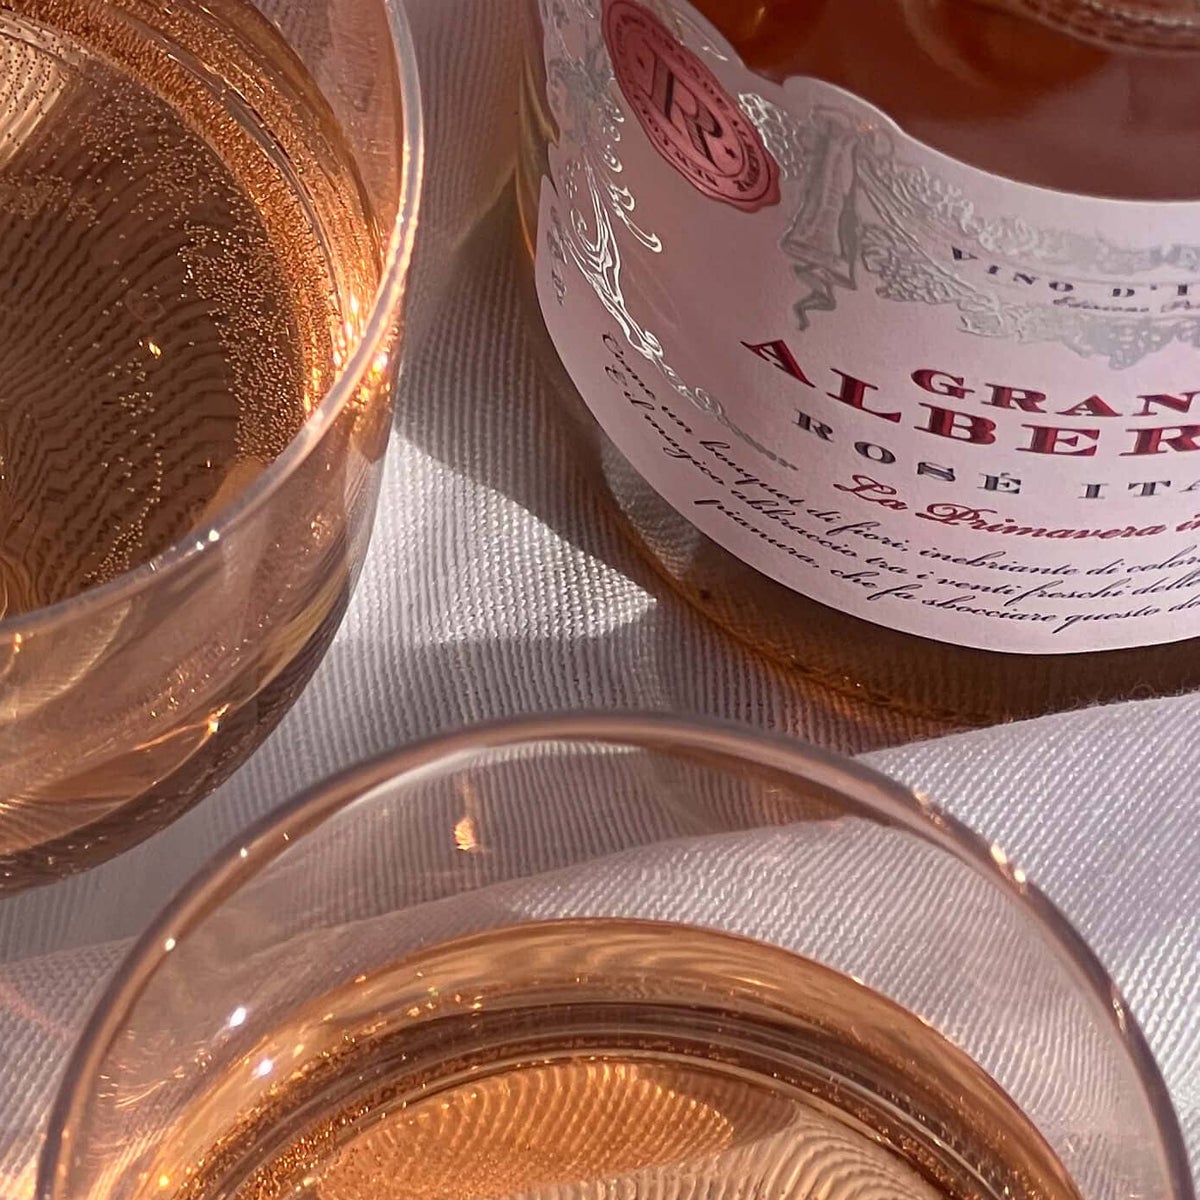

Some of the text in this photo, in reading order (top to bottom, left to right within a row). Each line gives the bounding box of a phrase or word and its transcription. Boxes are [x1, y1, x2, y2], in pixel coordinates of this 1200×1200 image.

[952, 246, 1075, 291] VINO
[739, 338, 1200, 456] ALBER
[911, 368, 1200, 416] GRAN
[661, 406, 693, 434] un
[699, 440, 804, 505] bouquet
[807, 509, 841, 523] di
[826, 521, 911, 551] fiori,
[919, 547, 1080, 575] inebriante
[1086, 558, 1125, 575] di
[1126, 545, 1200, 573] color
[792, 409, 1021, 495] ROSÉ
[644, 414, 725, 486] magico
[731, 489, 857, 557] abbraccio
[866, 557, 909, 574] tra
[917, 571, 934, 580] i
[937, 578, 1022, 595] venti
[1003, 578, 1132, 607] freschi
[833, 474, 908, 510] La
[915, 503, 1167, 539] Primavera
[694, 500, 819, 568] pianura,
[830, 569, 880, 588] che
[867, 584, 922, 600] fa
[921, 595, 1057, 621] sbocciare
[1052, 605, 1161, 634] questo
